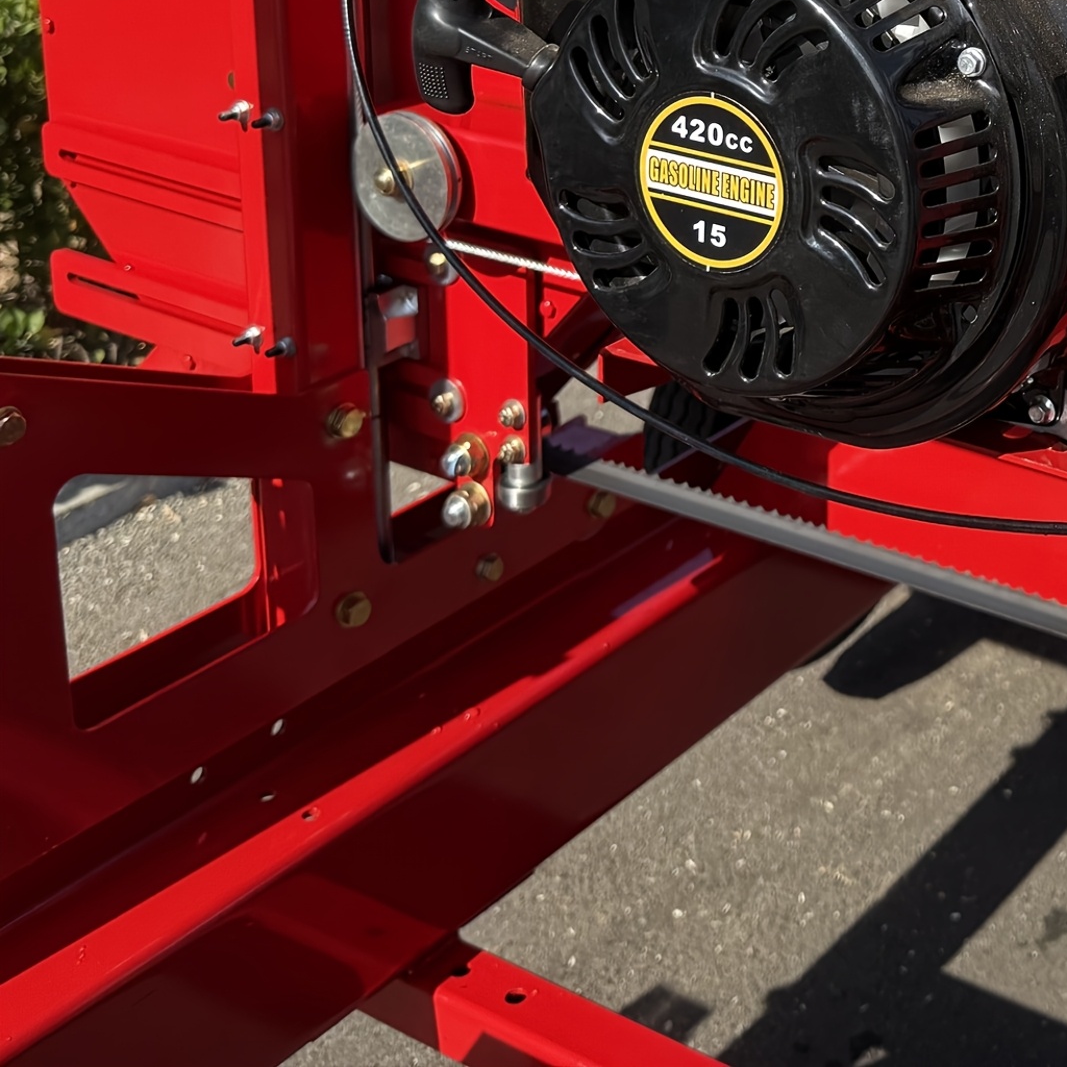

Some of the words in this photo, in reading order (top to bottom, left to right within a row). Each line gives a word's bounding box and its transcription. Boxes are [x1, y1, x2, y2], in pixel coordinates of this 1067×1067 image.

[671, 115, 753, 153] 420cc
[649, 156, 719, 196] GASOLINE
[721, 172, 775, 210] ENGINE
[693, 220, 727, 248] 15
